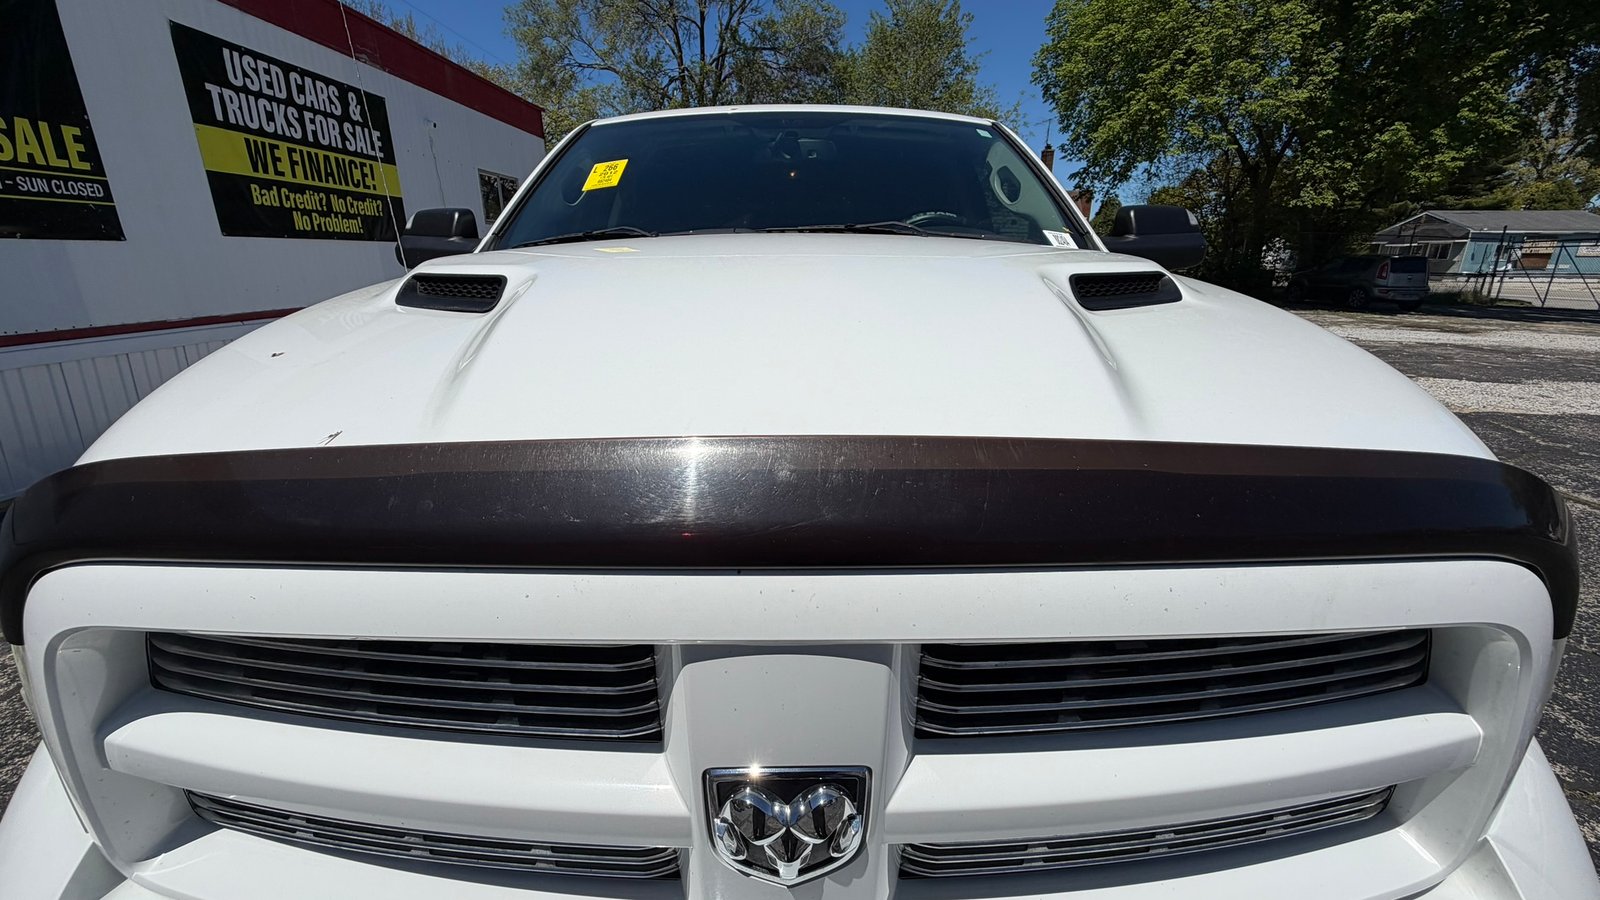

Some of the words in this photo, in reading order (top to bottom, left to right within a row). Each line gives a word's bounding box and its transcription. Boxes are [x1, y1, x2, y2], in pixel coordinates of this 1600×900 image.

[223, 48, 287, 99] USED
[289, 72, 342, 116] CARS
[347, 92, 363, 122] &
[204, 82, 303, 139] TRUCKS
[303, 111, 342, 149] FOR
[343, 122, 384, 158] SALE
[244, 137, 286, 177] WE
[286, 145, 377, 191] FINANCE!
[603, 163, 619, 171] 266
[15, 175, 50, 193] SUN
[51, 179, 104, 198] CLOSED
[250, 184, 280, 207] Bad
[281, 186, 327, 211] Credit?
[330, 194, 345, 213] No
[345, 196, 383, 217] Credit?
[293, 211, 311, 231] No
[313, 213, 364, 234] Problem!
